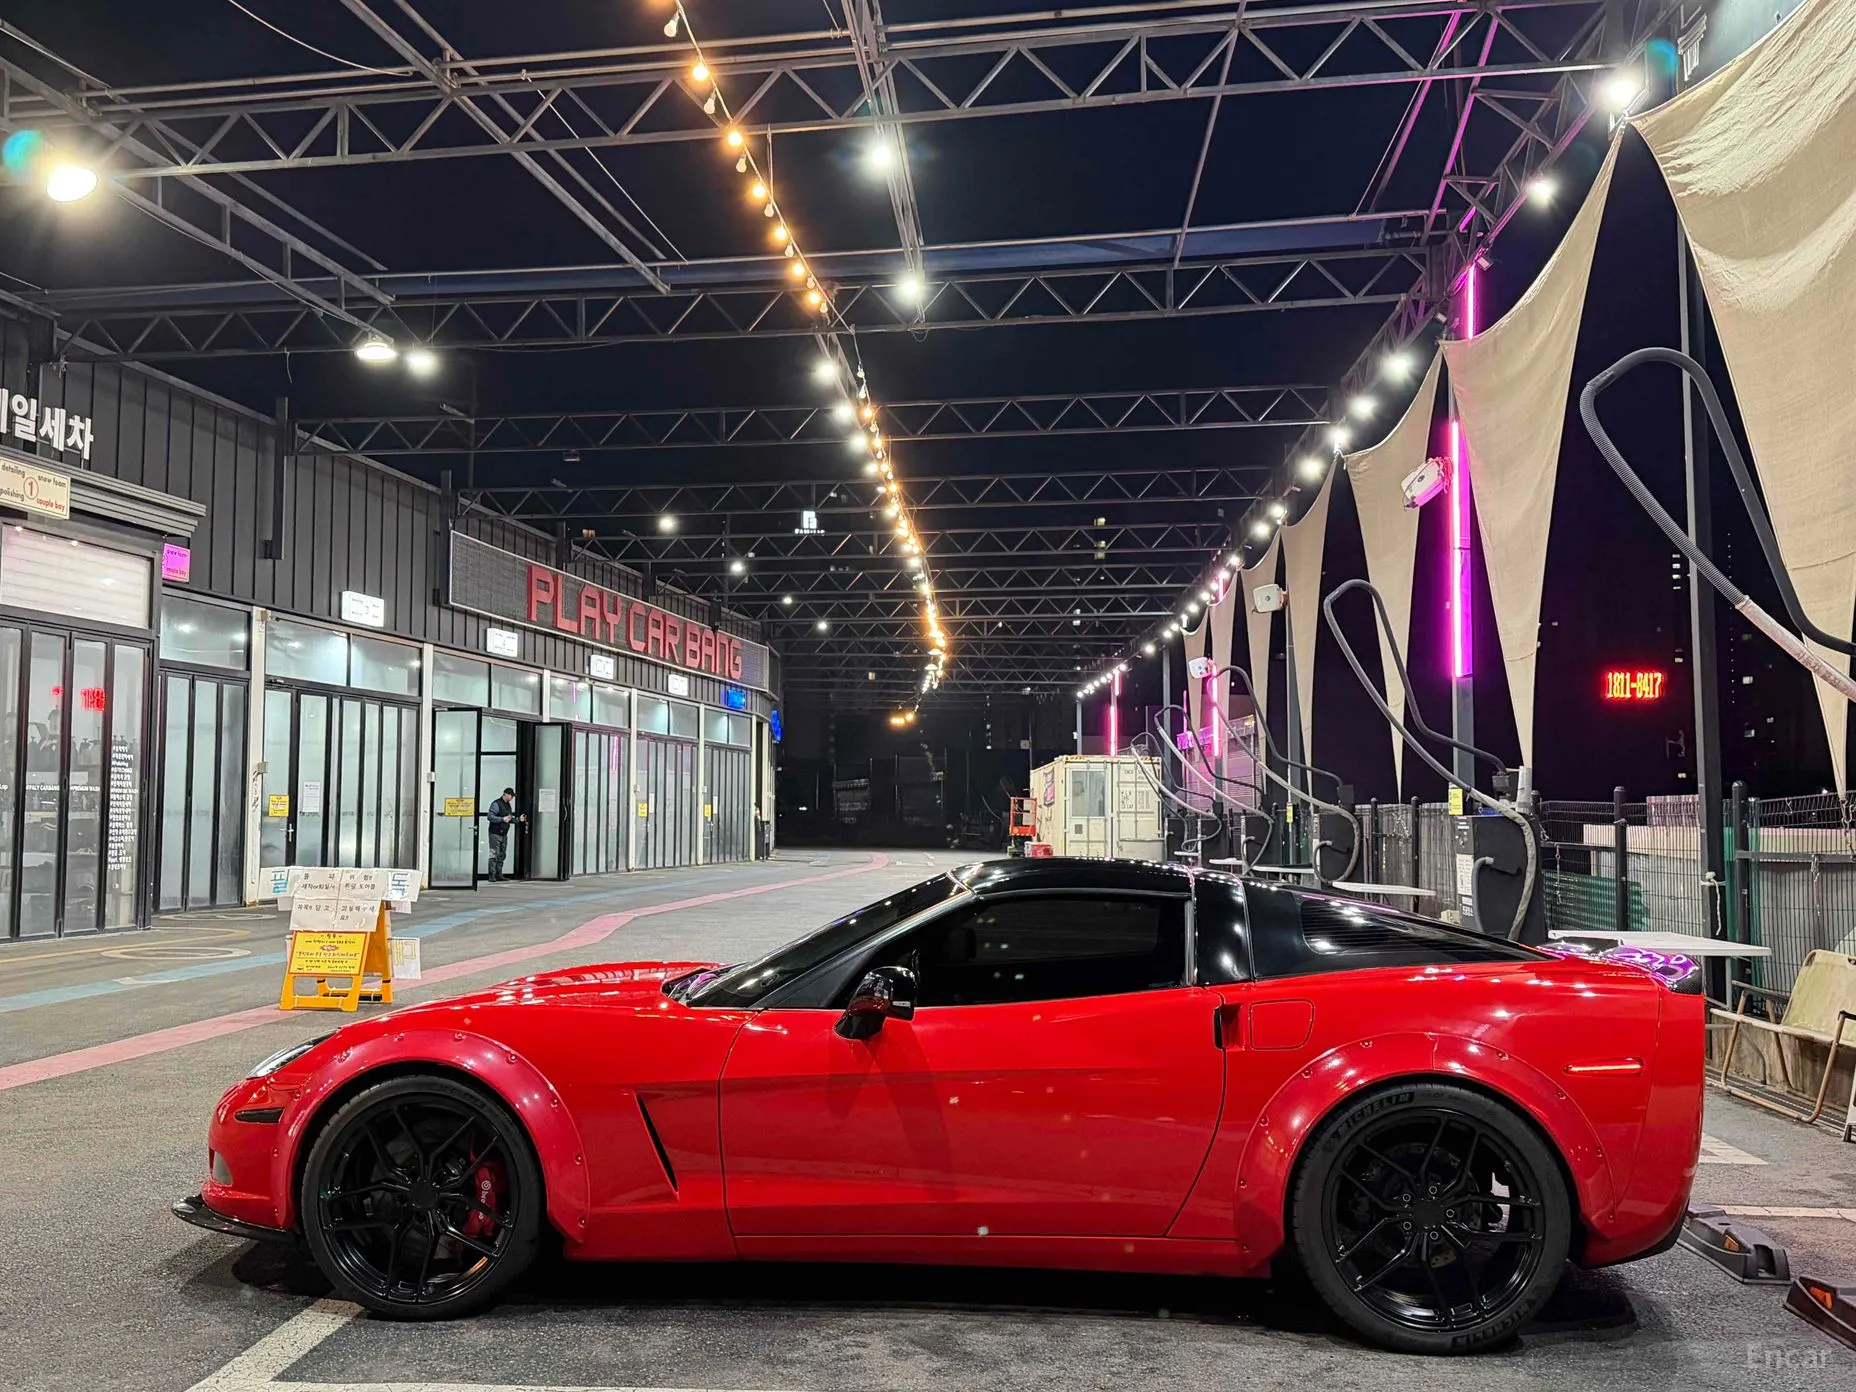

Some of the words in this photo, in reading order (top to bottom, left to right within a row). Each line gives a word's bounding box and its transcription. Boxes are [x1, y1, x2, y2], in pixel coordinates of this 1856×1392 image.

[1, 462, 25, 479] detailing
[53, 477, 66, 488] foam
[0, 488, 24, 502] polishing
[36, 498, 54, 508] couple
[528, 564, 622, 644] PLAY
[626, 601, 681, 664] CAR
[684, 621, 744, 681] BANG
[1606, 671, 1663, 699] 1811-8417
[1335, 1092, 1414, 1138] MICHELIN
